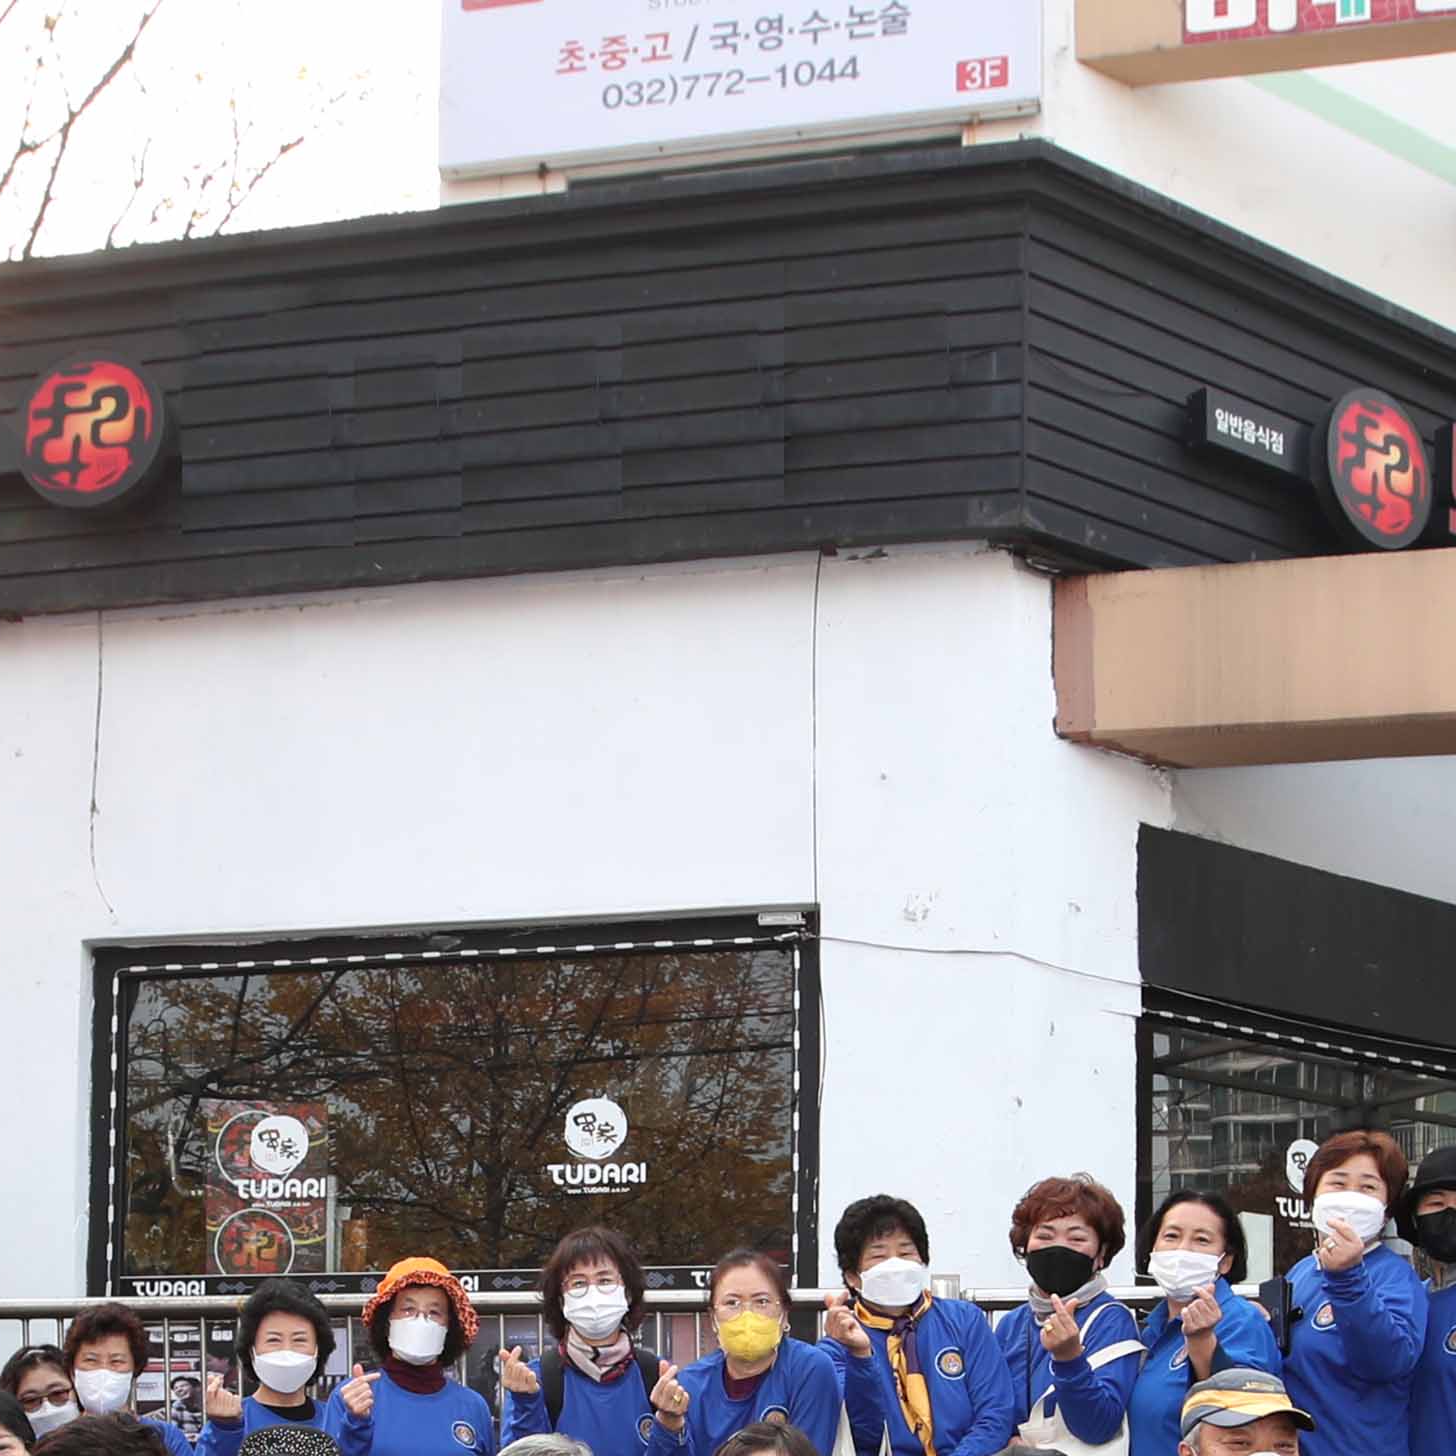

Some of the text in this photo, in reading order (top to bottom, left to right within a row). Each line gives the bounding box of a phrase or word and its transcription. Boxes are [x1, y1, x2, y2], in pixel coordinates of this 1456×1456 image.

[602, 54, 861, 109] 032)772-1044
[965, 59, 1002, 89] 3F
[1214, 407, 1285, 456] 일반음식점
[547, 1162, 646, 1185] TUDARI
[234, 1177, 326, 1199] TUDARI
[133, 1280, 205, 1296] TUDARI
